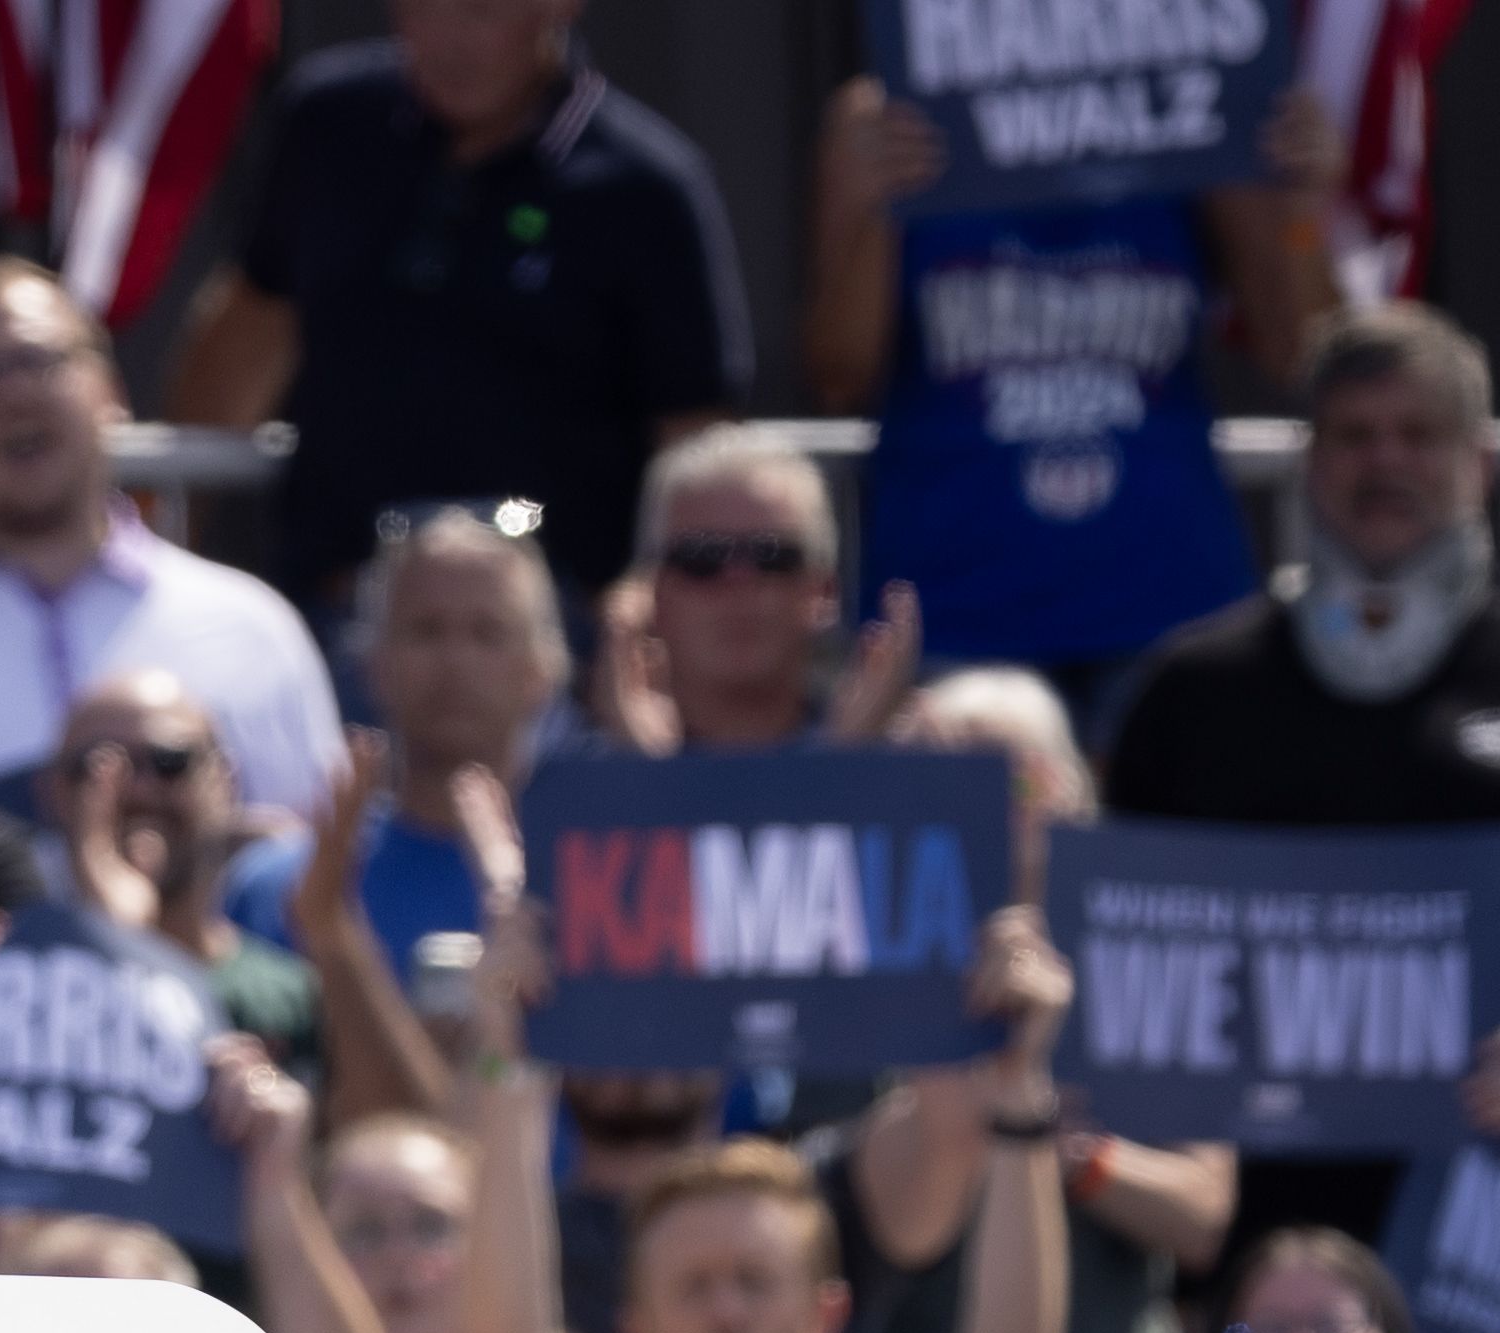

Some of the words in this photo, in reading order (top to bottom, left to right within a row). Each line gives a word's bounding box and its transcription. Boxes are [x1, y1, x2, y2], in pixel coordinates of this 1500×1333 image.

[972, 68, 1230, 170] WALZ
[555, 823, 978, 980] KAMALA
[1086, 880, 1240, 934] WHEN
[1248, 890, 1322, 936] WE
[1082, 938, 1240, 1070] WE
[1252, 942, 1474, 1078] WIN
